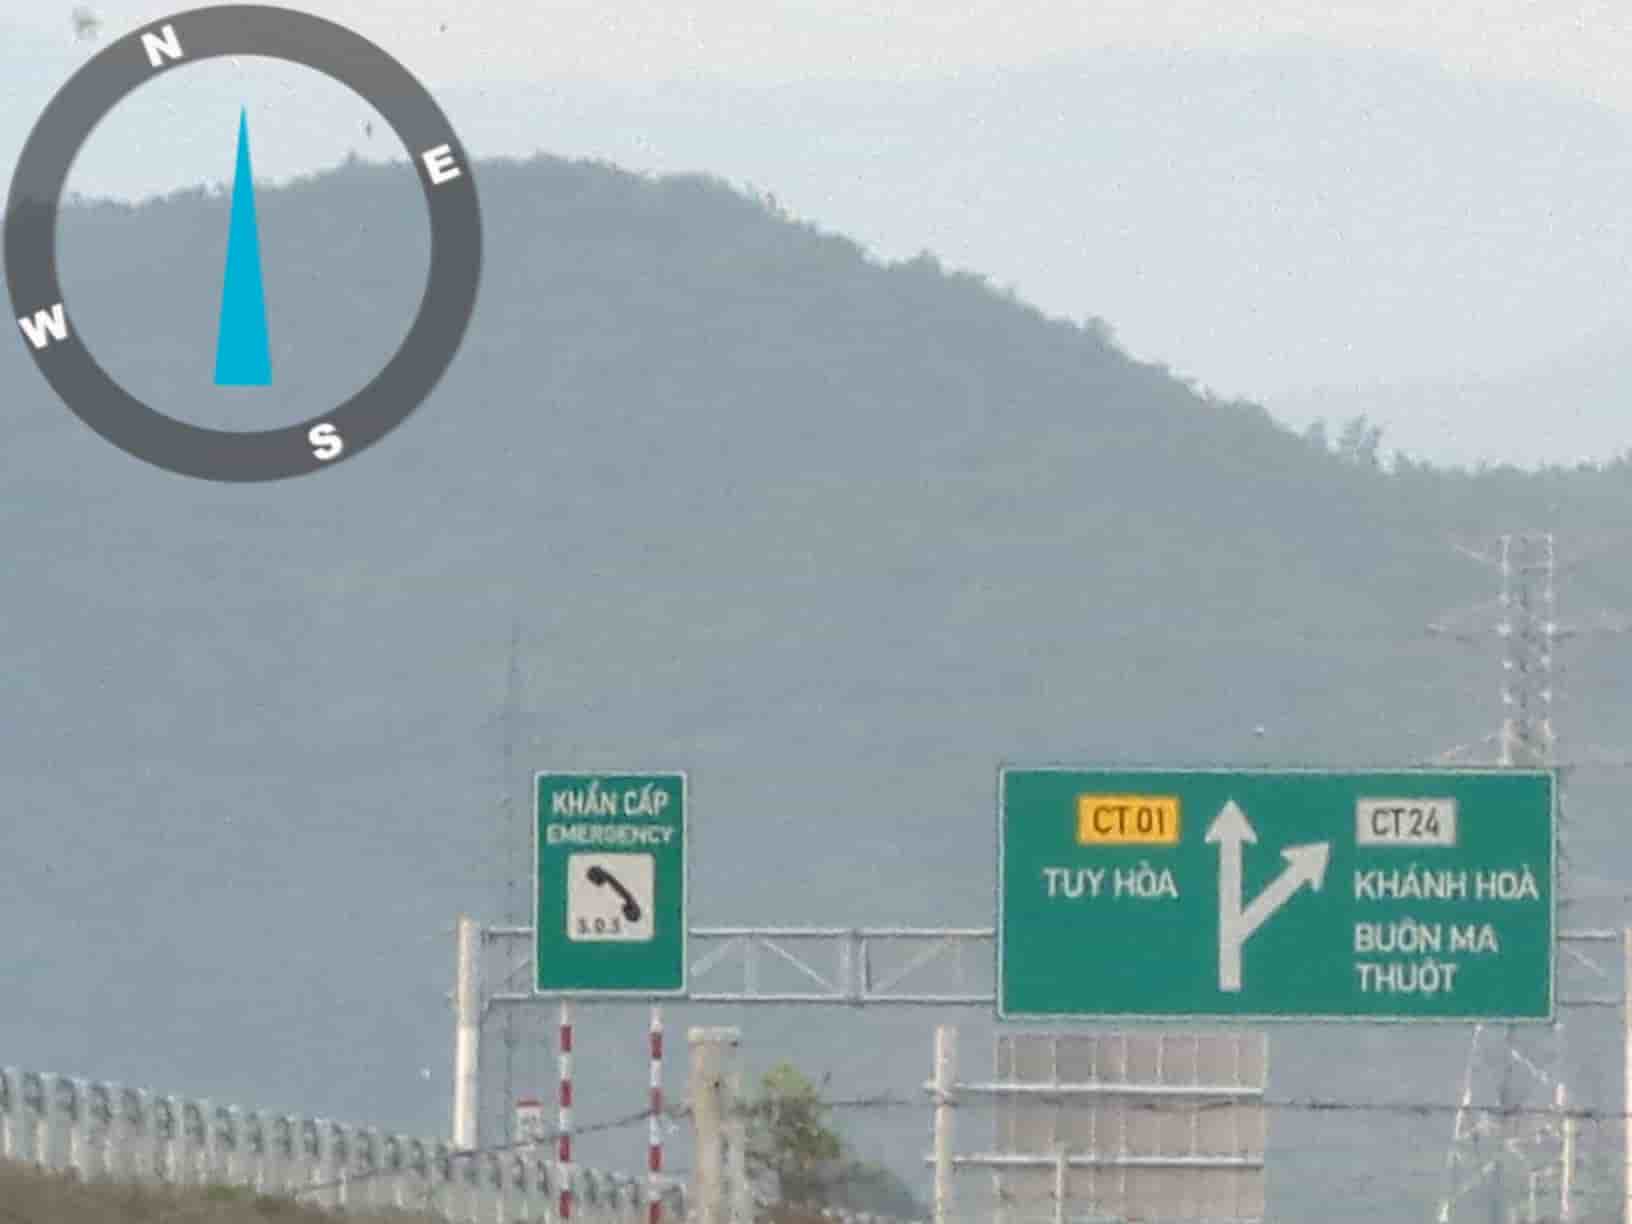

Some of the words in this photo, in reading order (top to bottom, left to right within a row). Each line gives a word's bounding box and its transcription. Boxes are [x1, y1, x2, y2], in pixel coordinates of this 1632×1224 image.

[1371, 807, 1440, 837] CT24
[1043, 868, 1105, 898] TUY
[1114, 859, 1179, 899] HÒA
[1354, 862, 1467, 901] KHÁNH
[1476, 863, 1540, 901] HOÀ
[1354, 916, 1442, 953] BUÔN
[1450, 923, 1499, 953] MA
